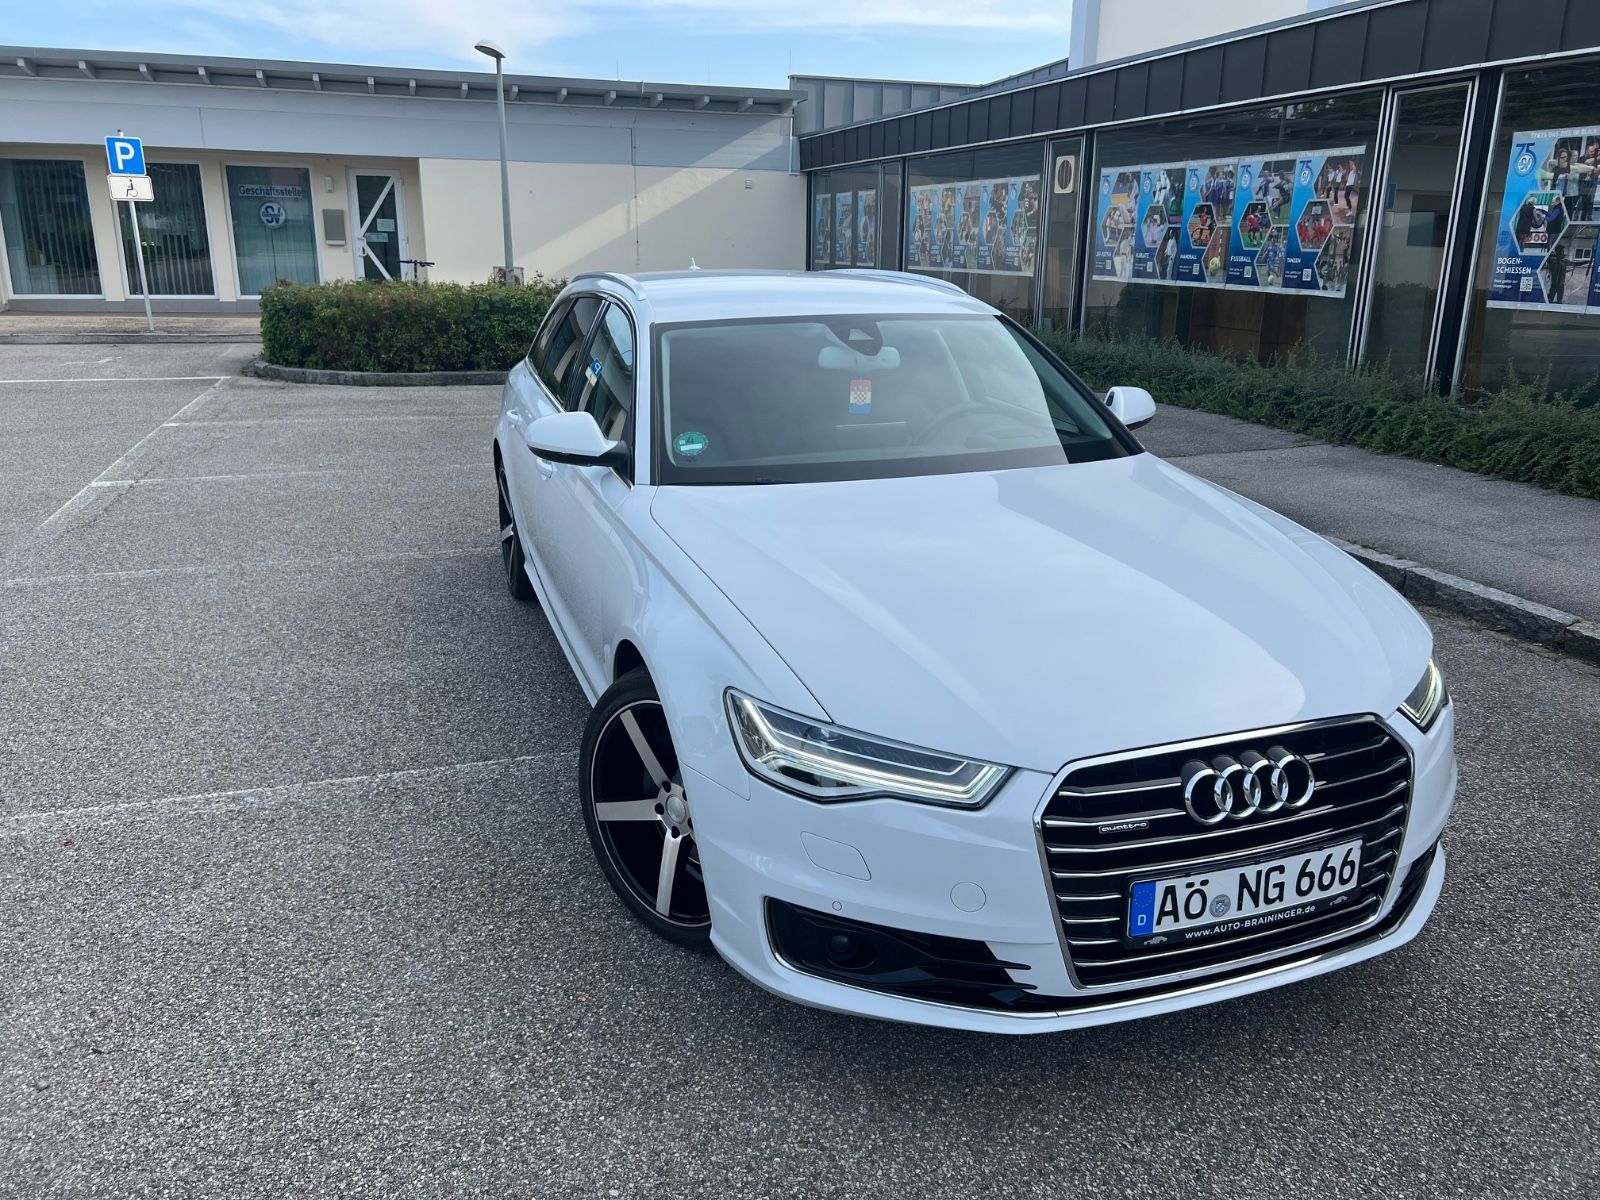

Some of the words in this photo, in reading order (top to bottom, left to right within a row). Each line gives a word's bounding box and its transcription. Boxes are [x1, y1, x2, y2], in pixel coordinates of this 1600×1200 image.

[114, 141, 135, 170] P
[1497, 257, 1523, 265] BOGEN-
[1495, 266, 1532, 275] SCHIESSEN
[1101, 822, 1148, 832] quattro
[1155, 878, 1209, 926] AÖ
[1236, 864, 1286, 911] NG
[1295, 847, 1356, 897] 666
[1137, 914, 1147, 926] D
[1185, 904, 1316, 940] www.AUTO-BRAININGER.de
